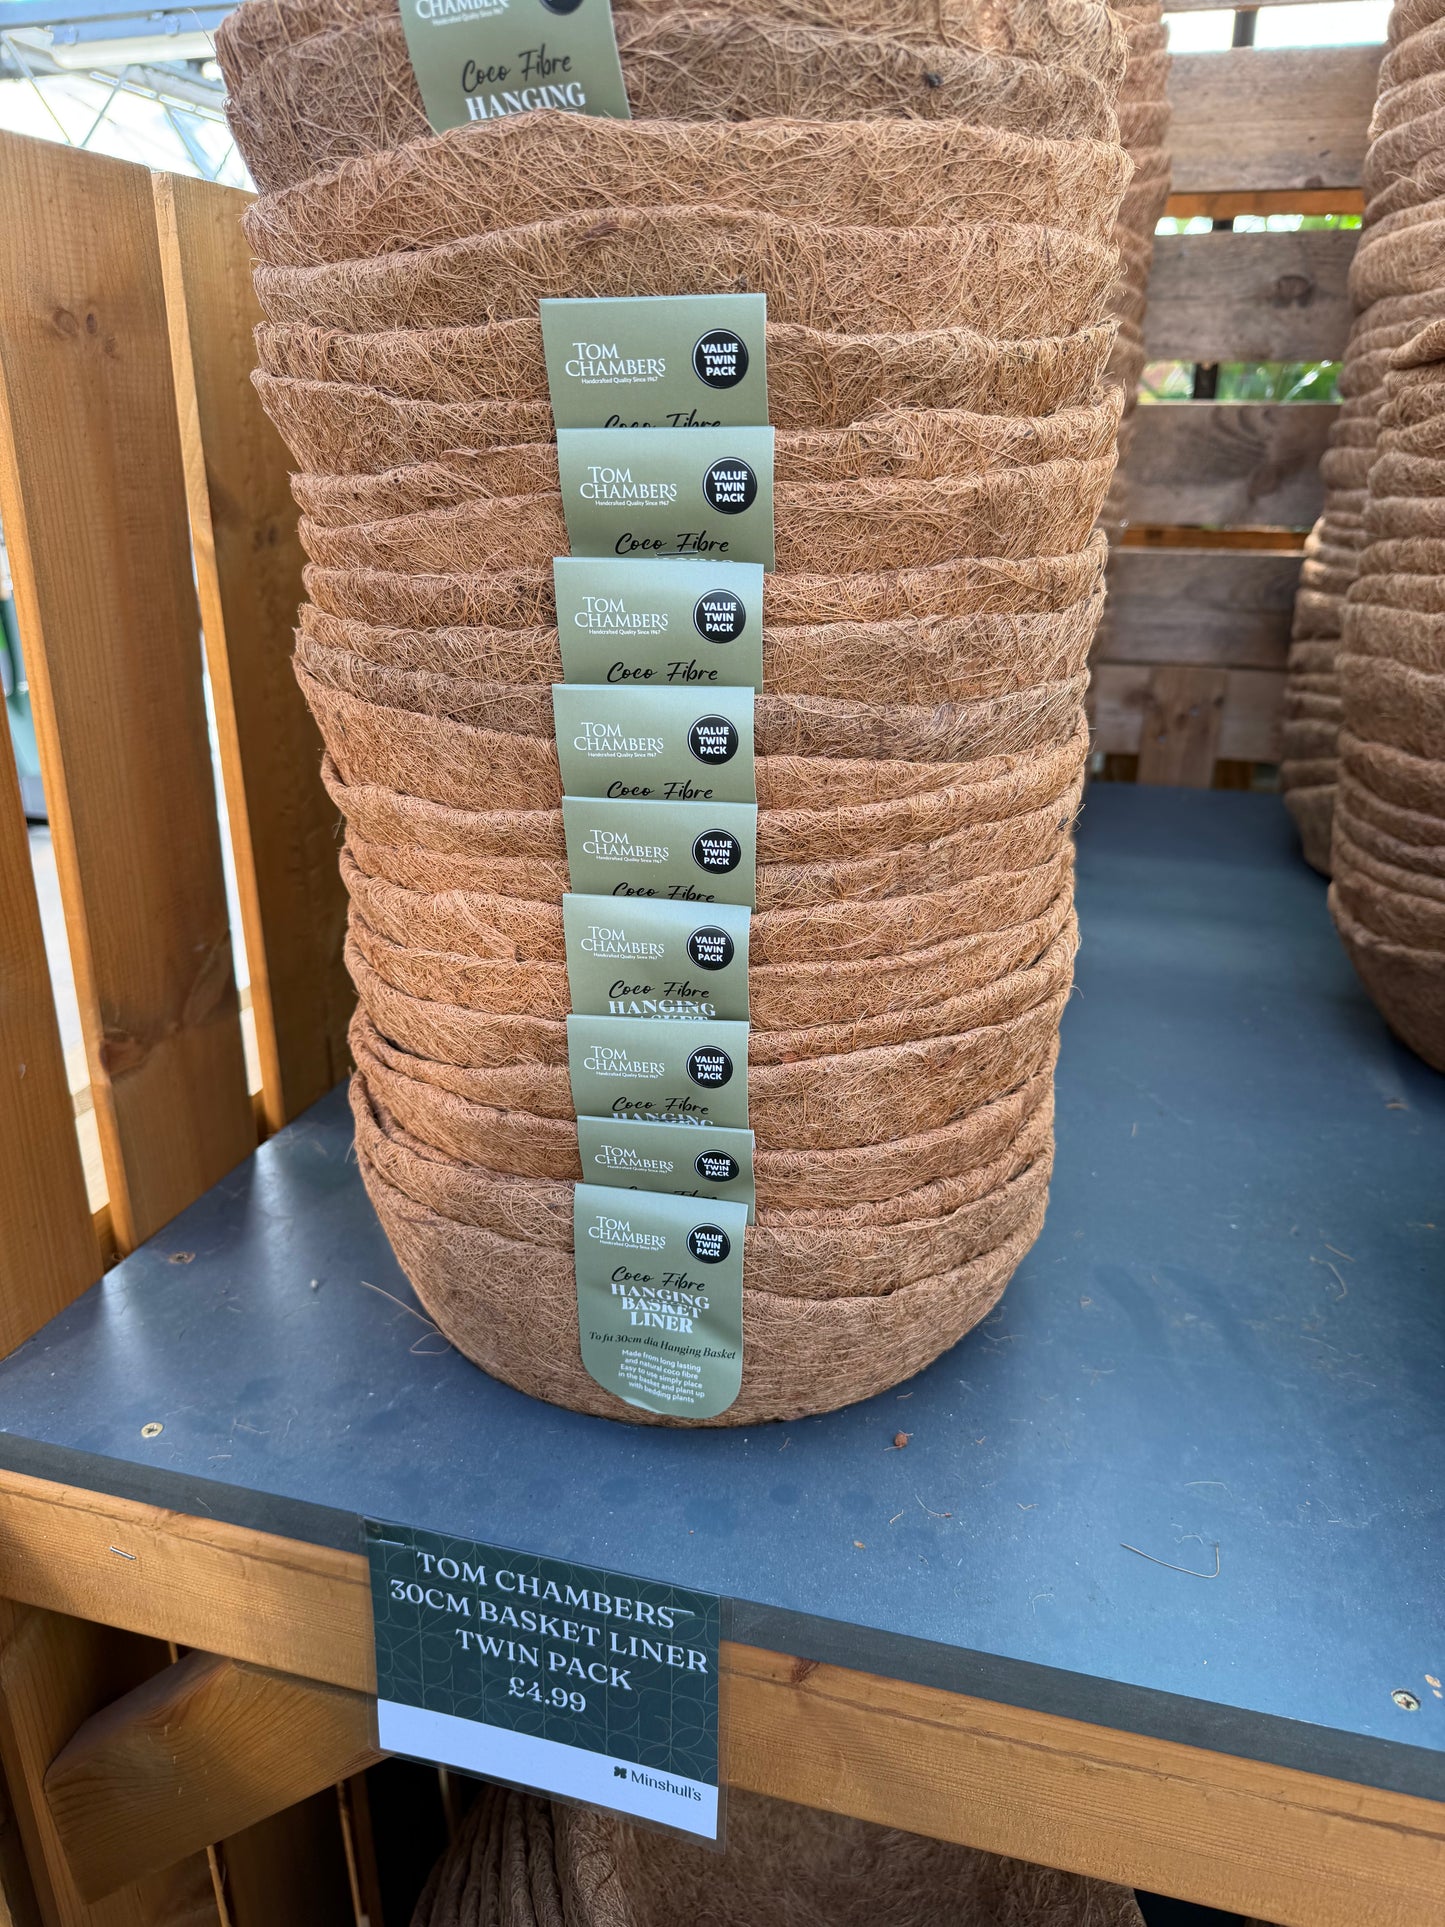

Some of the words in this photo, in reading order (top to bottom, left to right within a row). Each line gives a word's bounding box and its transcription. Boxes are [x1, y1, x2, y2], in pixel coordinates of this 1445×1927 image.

[462, 60, 510, 93] Coco
[518, 43, 572, 81] Fibre
[465, 82, 586, 121] HANGING
[572, 343, 620, 360] TOM
[701, 343, 738, 353] VALUE
[565, 358, 665, 377] CHAMBERS
[704, 355, 736, 365] TWIN
[706, 367, 736, 376] PACK
[588, 466, 633, 483] TOM
[712, 471, 747, 481] VALUE
[580, 483, 677, 502] CHAMBERS
[715, 482, 745, 491] TWIN
[716, 493, 744, 502] PACK
[615, 533, 667, 554] Coco
[677, 530, 729, 552] Fibre
[582, 596, 625, 613] TOM
[702, 602, 736, 611] VALUE
[574, 613, 668, 630] CHAMBERS
[705, 613, 734, 621] TWIN
[706, 624, 733, 632] PACK
[607, 662, 657, 683] Coco
[667, 659, 718, 682] Fibre
[581, 722, 622, 737] TOM
[696, 727, 729, 735] VALUE
[574, 737, 664, 753] CHAMBERS
[699, 737, 727, 745] TWIN
[700, 747, 727, 755] PACK
[607, 780, 655, 799] Coco
[664, 780, 713, 800] Fibre
[590, 829, 629, 844] TOM
[701, 840, 732, 848] VALUE
[583, 842, 669, 861] CHAMBERS
[703, 849, 729, 857] TWIN
[613, 882, 659, 896] Coco
[669, 885, 715, 903] Fibre
[588, 926, 625, 941] TOM
[695, 936, 726, 945] VALUE
[581, 939, 664, 957] CHAMBERS
[697, 945, 723, 953] TWIN
[698, 954, 723, 962] PACK
[609, 980, 655, 998] Coco
[664, 981, 710, 998] Fibre
[609, 1000, 716, 1016] HANGING
[590, 1046, 627, 1060] TOM
[694, 1056, 724, 1064] VALUE
[584, 1058, 664, 1076] CHAMBERS
[612, 1097, 656, 1111] Coco
[665, 1097, 708, 1115] Fibre
[601, 1145, 636, 1158] TOM
[595, 1155, 673, 1172] CHAMBERS
[702, 1157, 731, 1166] VALUE
[596, 1216, 630, 1232] TOM
[588, 1227, 666, 1249] CHAMBERS
[694, 1232, 723, 1242] VALUE
[696, 1241, 721, 1249] TWIN
[696, 1248, 720, 1257] PACK
[612, 1266, 654, 1282] Coco
[662, 1272, 705, 1291] Fibre
[611, 1283, 710, 1310] HANGING
[622, 1297, 702, 1318] BASKET
[630, 1311, 693, 1333] LINER
[589, 1331, 601, 1340] To
[615, 1334, 641, 1343] 30cm
[644, 1336, 658, 1347] dia
[660, 1340, 701, 1357] Hanging
[703, 1347, 736, 1359] Basket
[622, 1349, 641, 1357] Made
[643, 1352, 658, 1361] from
[660, 1357, 675, 1368] long
[677, 1361, 701, 1372] lasting
[620, 1364, 636, 1372] Easy
[659, 1375, 681, 1385] simply
[683, 1380, 702, 1388] place
[640, 1360, 662, 1371] natural
[682, 1370, 698, 1379] fibre
[627, 1372, 637, 1380] the
[639, 1375, 660, 1388] basket
[676, 1386, 694, 1395] plant
[629, 1381, 643, 1389] with
[644, 1385, 671, 1400] bedding
[672, 1394, 694, 1403] plants
[417, 1552, 488, 1586] TOM
[495, 1570, 675, 1629] CHAMBERS
[390, 1579, 472, 1616] 30CM
[479, 1600, 600, 1647] BASKET
[610, 1631, 709, 1674] LINER
[456, 1628, 539, 1668] TWIN
[548, 1651, 633, 1691] PACK
[508, 1677, 587, 1713] £4.99
[631, 1769, 702, 1802] Minshull's
